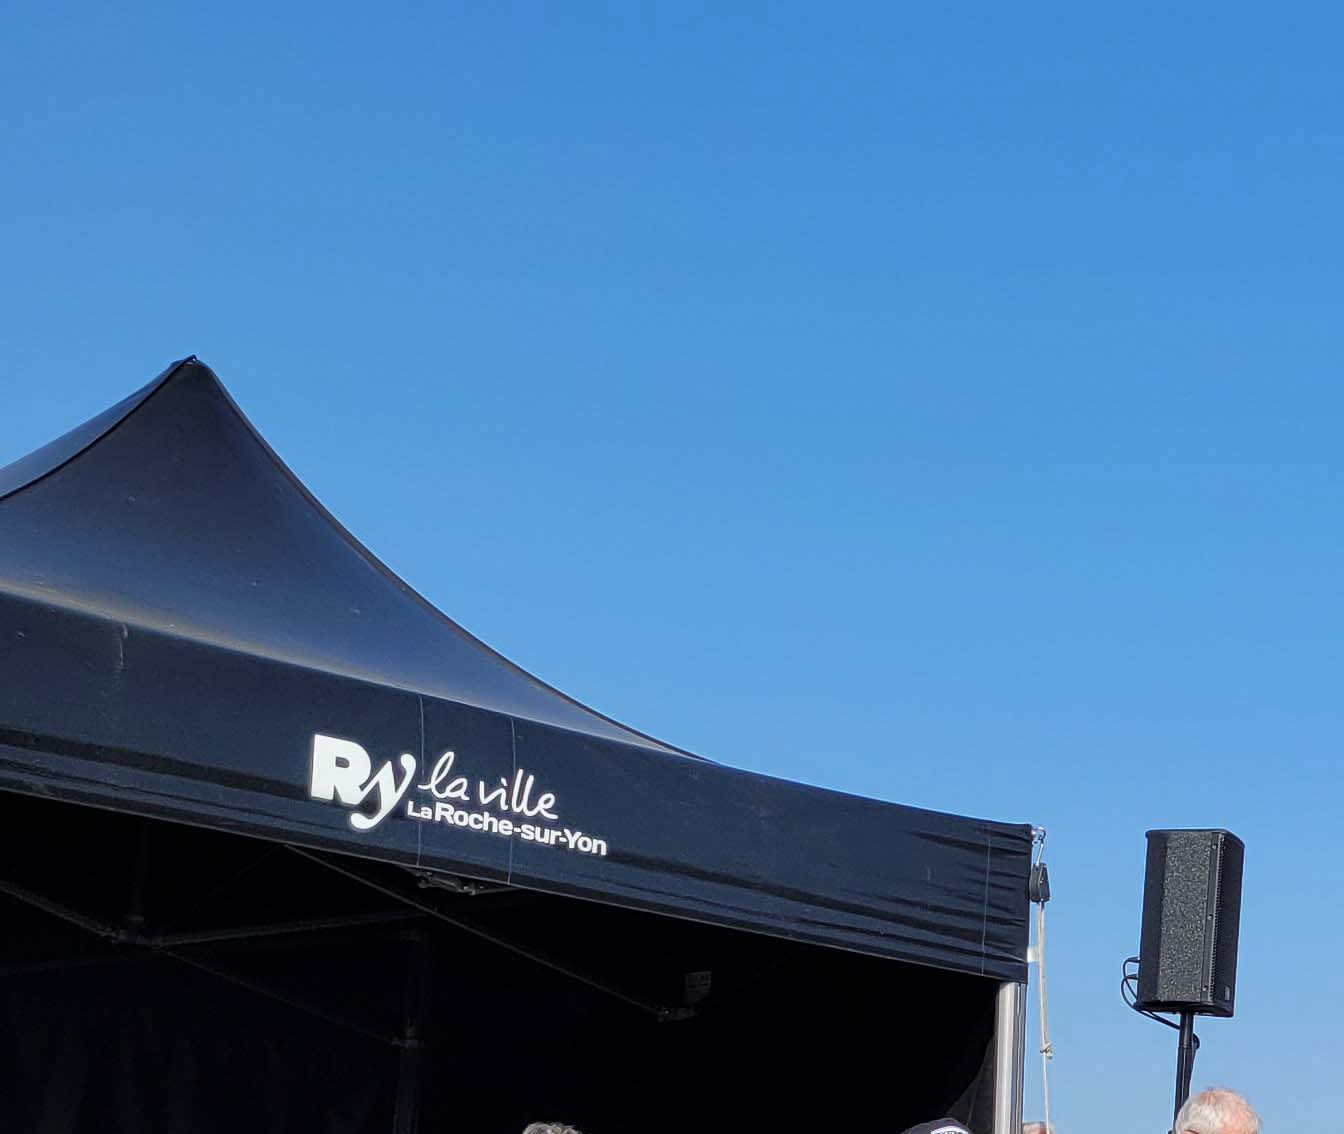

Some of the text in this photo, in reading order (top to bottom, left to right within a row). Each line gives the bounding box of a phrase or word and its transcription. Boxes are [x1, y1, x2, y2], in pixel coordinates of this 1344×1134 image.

[310, 734, 416, 830] Ry
[417, 751, 559, 820] la ville
[407, 801, 607, 856] La Roche-sur-Yon
